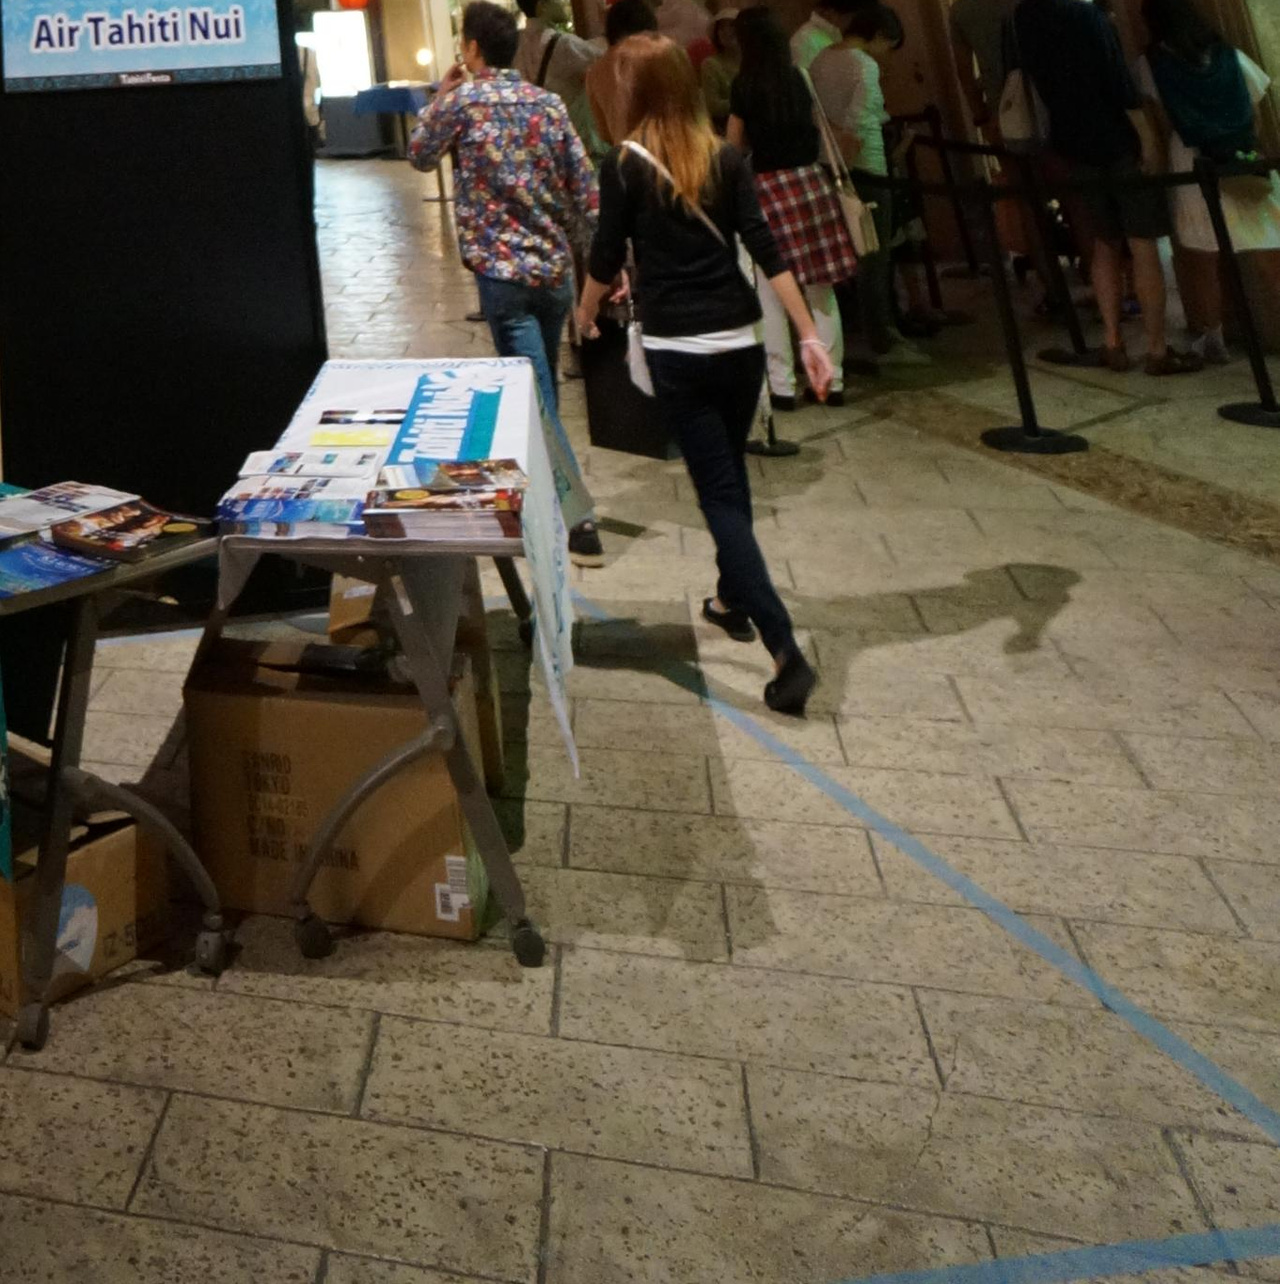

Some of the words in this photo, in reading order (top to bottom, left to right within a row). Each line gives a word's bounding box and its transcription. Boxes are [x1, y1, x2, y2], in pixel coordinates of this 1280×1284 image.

[34, 16, 79, 48] Air
[88, 11, 179, 46] Tahiti
[189, 9, 242, 41] Nui
